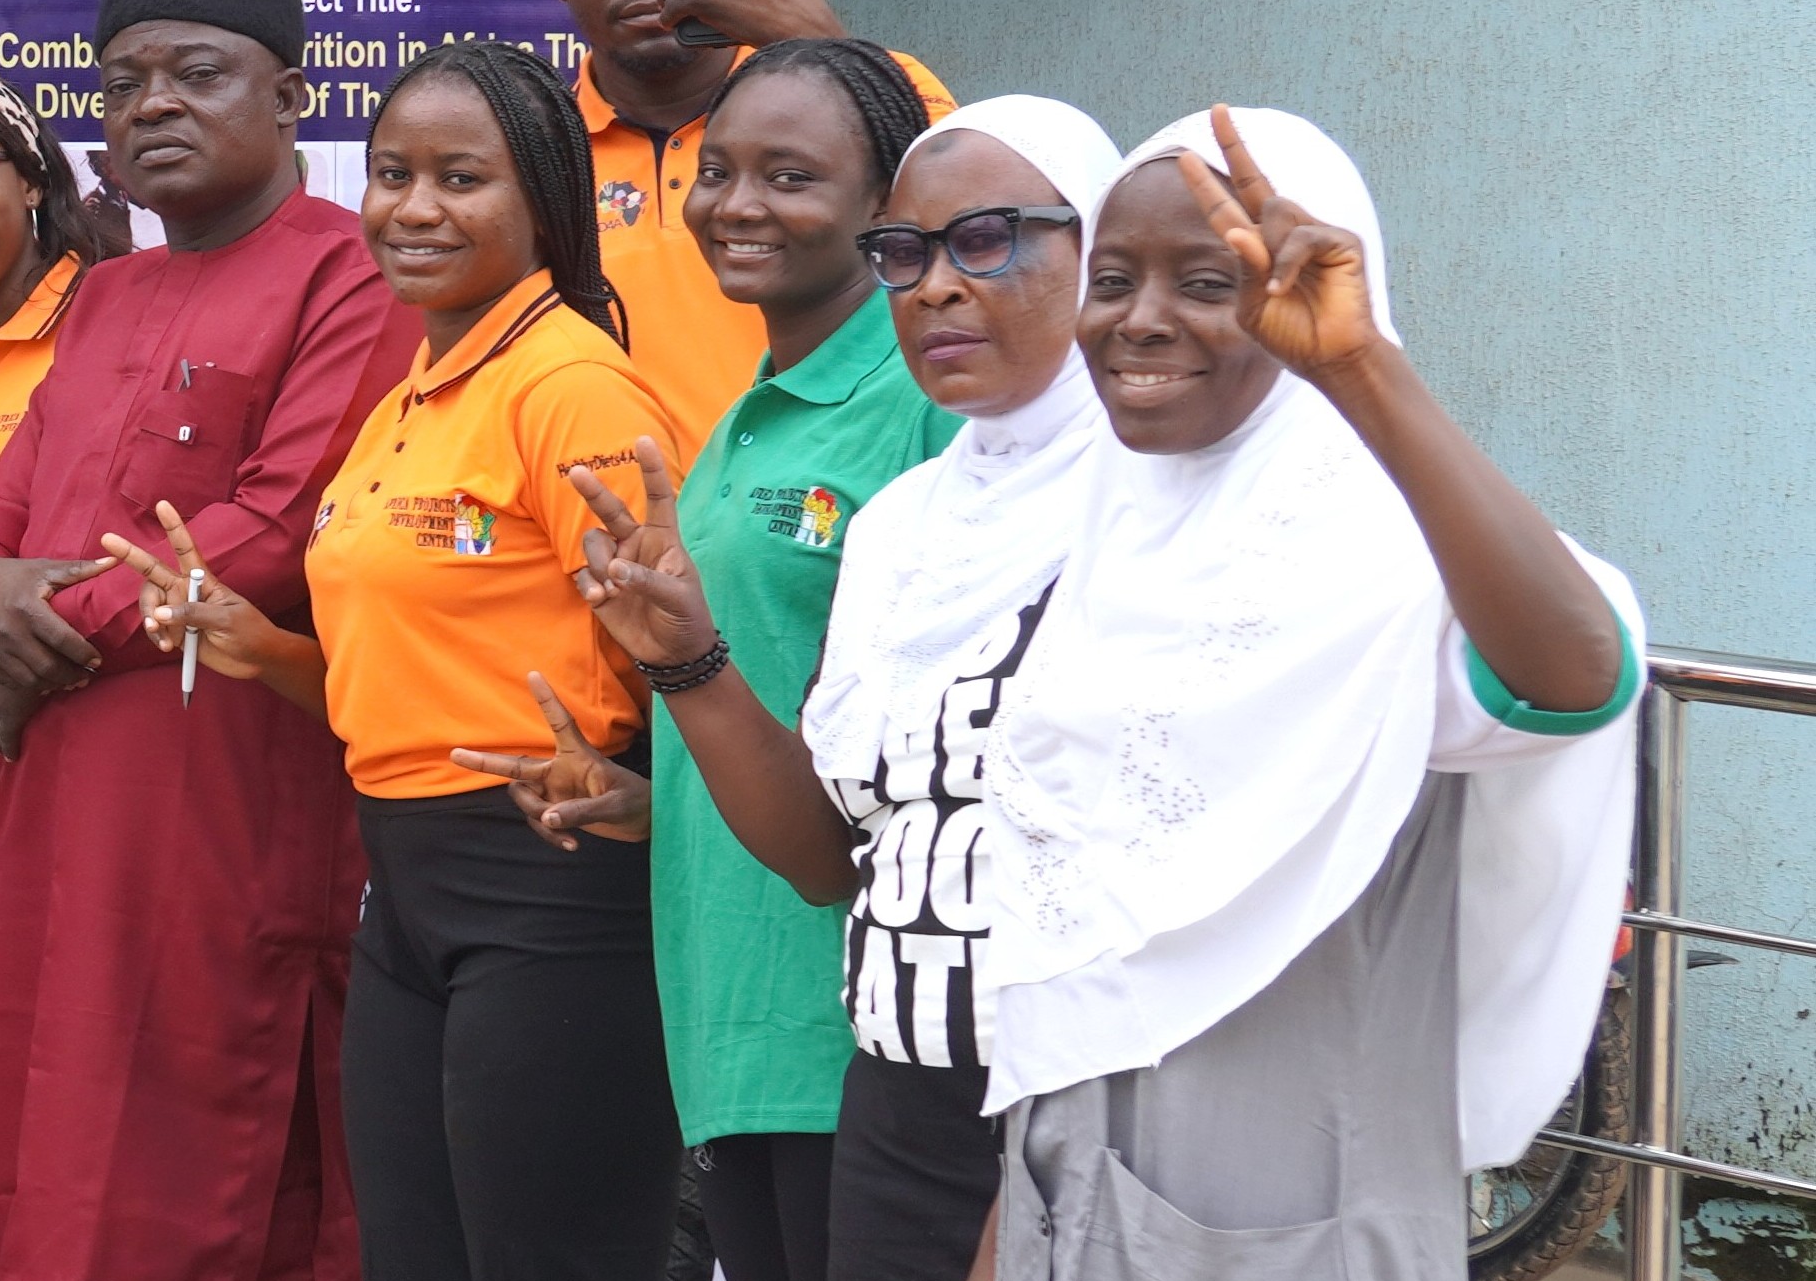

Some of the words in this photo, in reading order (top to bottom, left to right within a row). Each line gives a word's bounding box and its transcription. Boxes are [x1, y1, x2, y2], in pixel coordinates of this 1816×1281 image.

[302, 32, 386, 68] rition
[35, 82, 104, 118] Dive
[339, 82, 381, 118] Th
[597, 219, 624, 233] D4A
